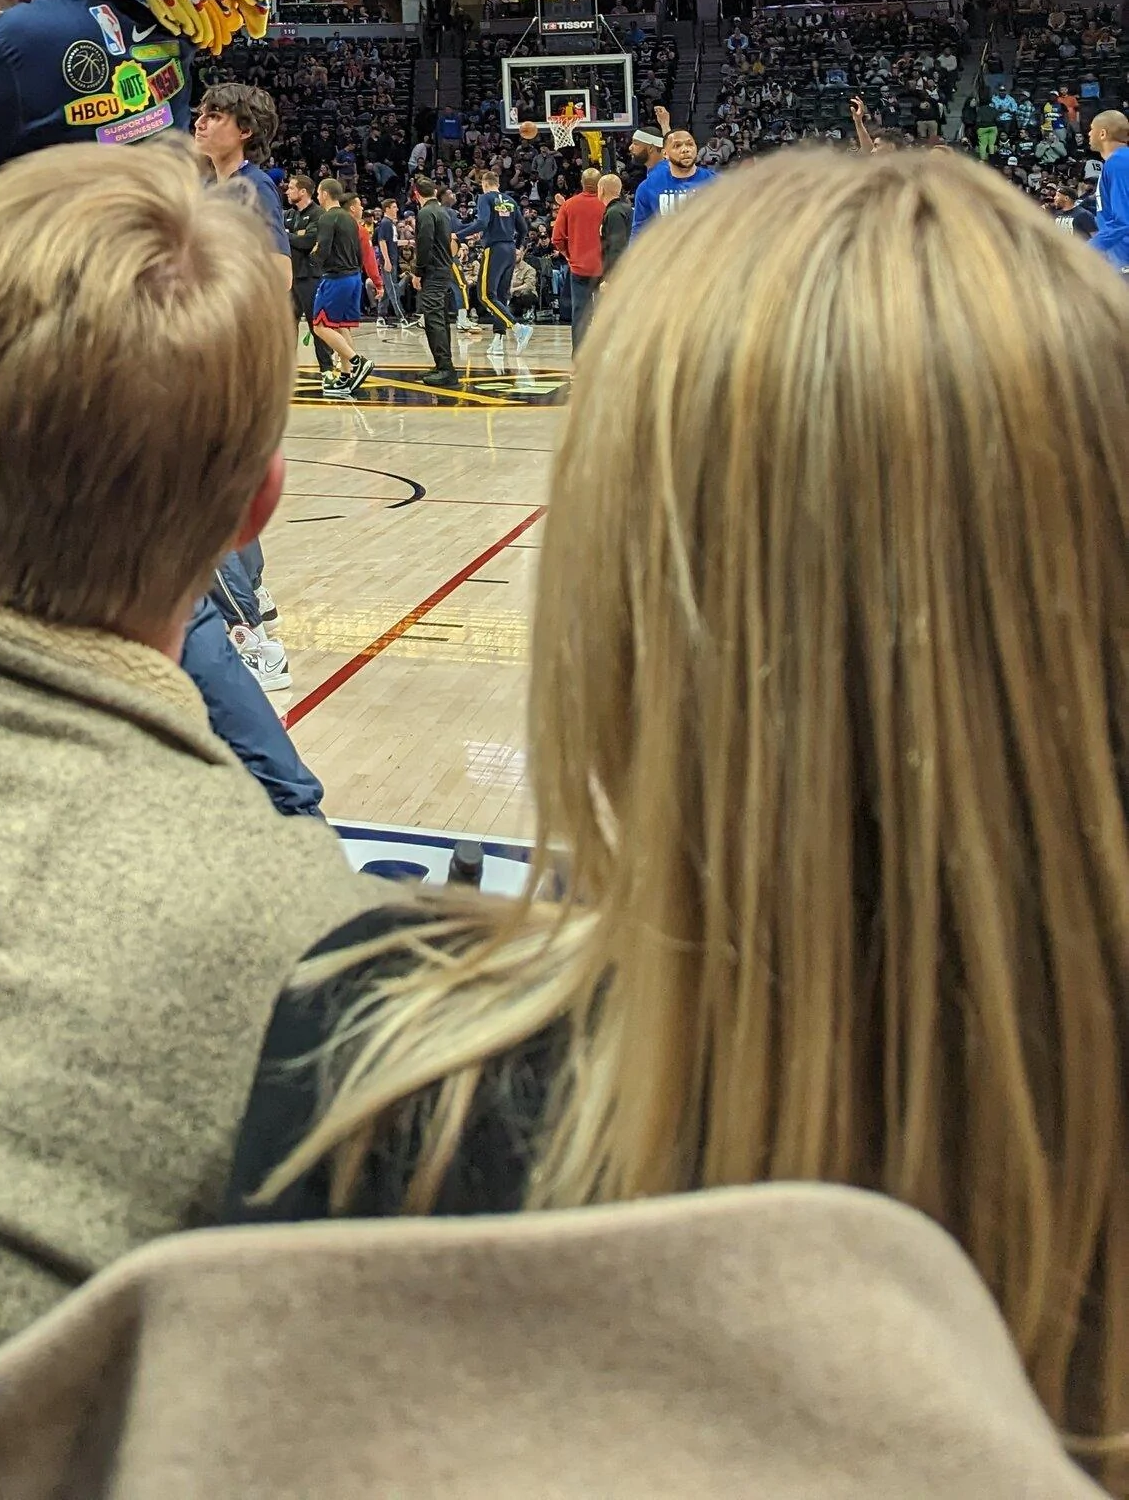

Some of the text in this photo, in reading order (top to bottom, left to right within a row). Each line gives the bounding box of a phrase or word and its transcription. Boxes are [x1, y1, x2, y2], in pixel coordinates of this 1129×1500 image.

[558, 20, 595, 30] TISSOT
[119, 73, 146, 101] VOTE
[71, 97, 120, 122] HBCU
[103, 107, 167, 136] SUPPORT BLACK
[115, 118, 164, 142] BUSINESSES
